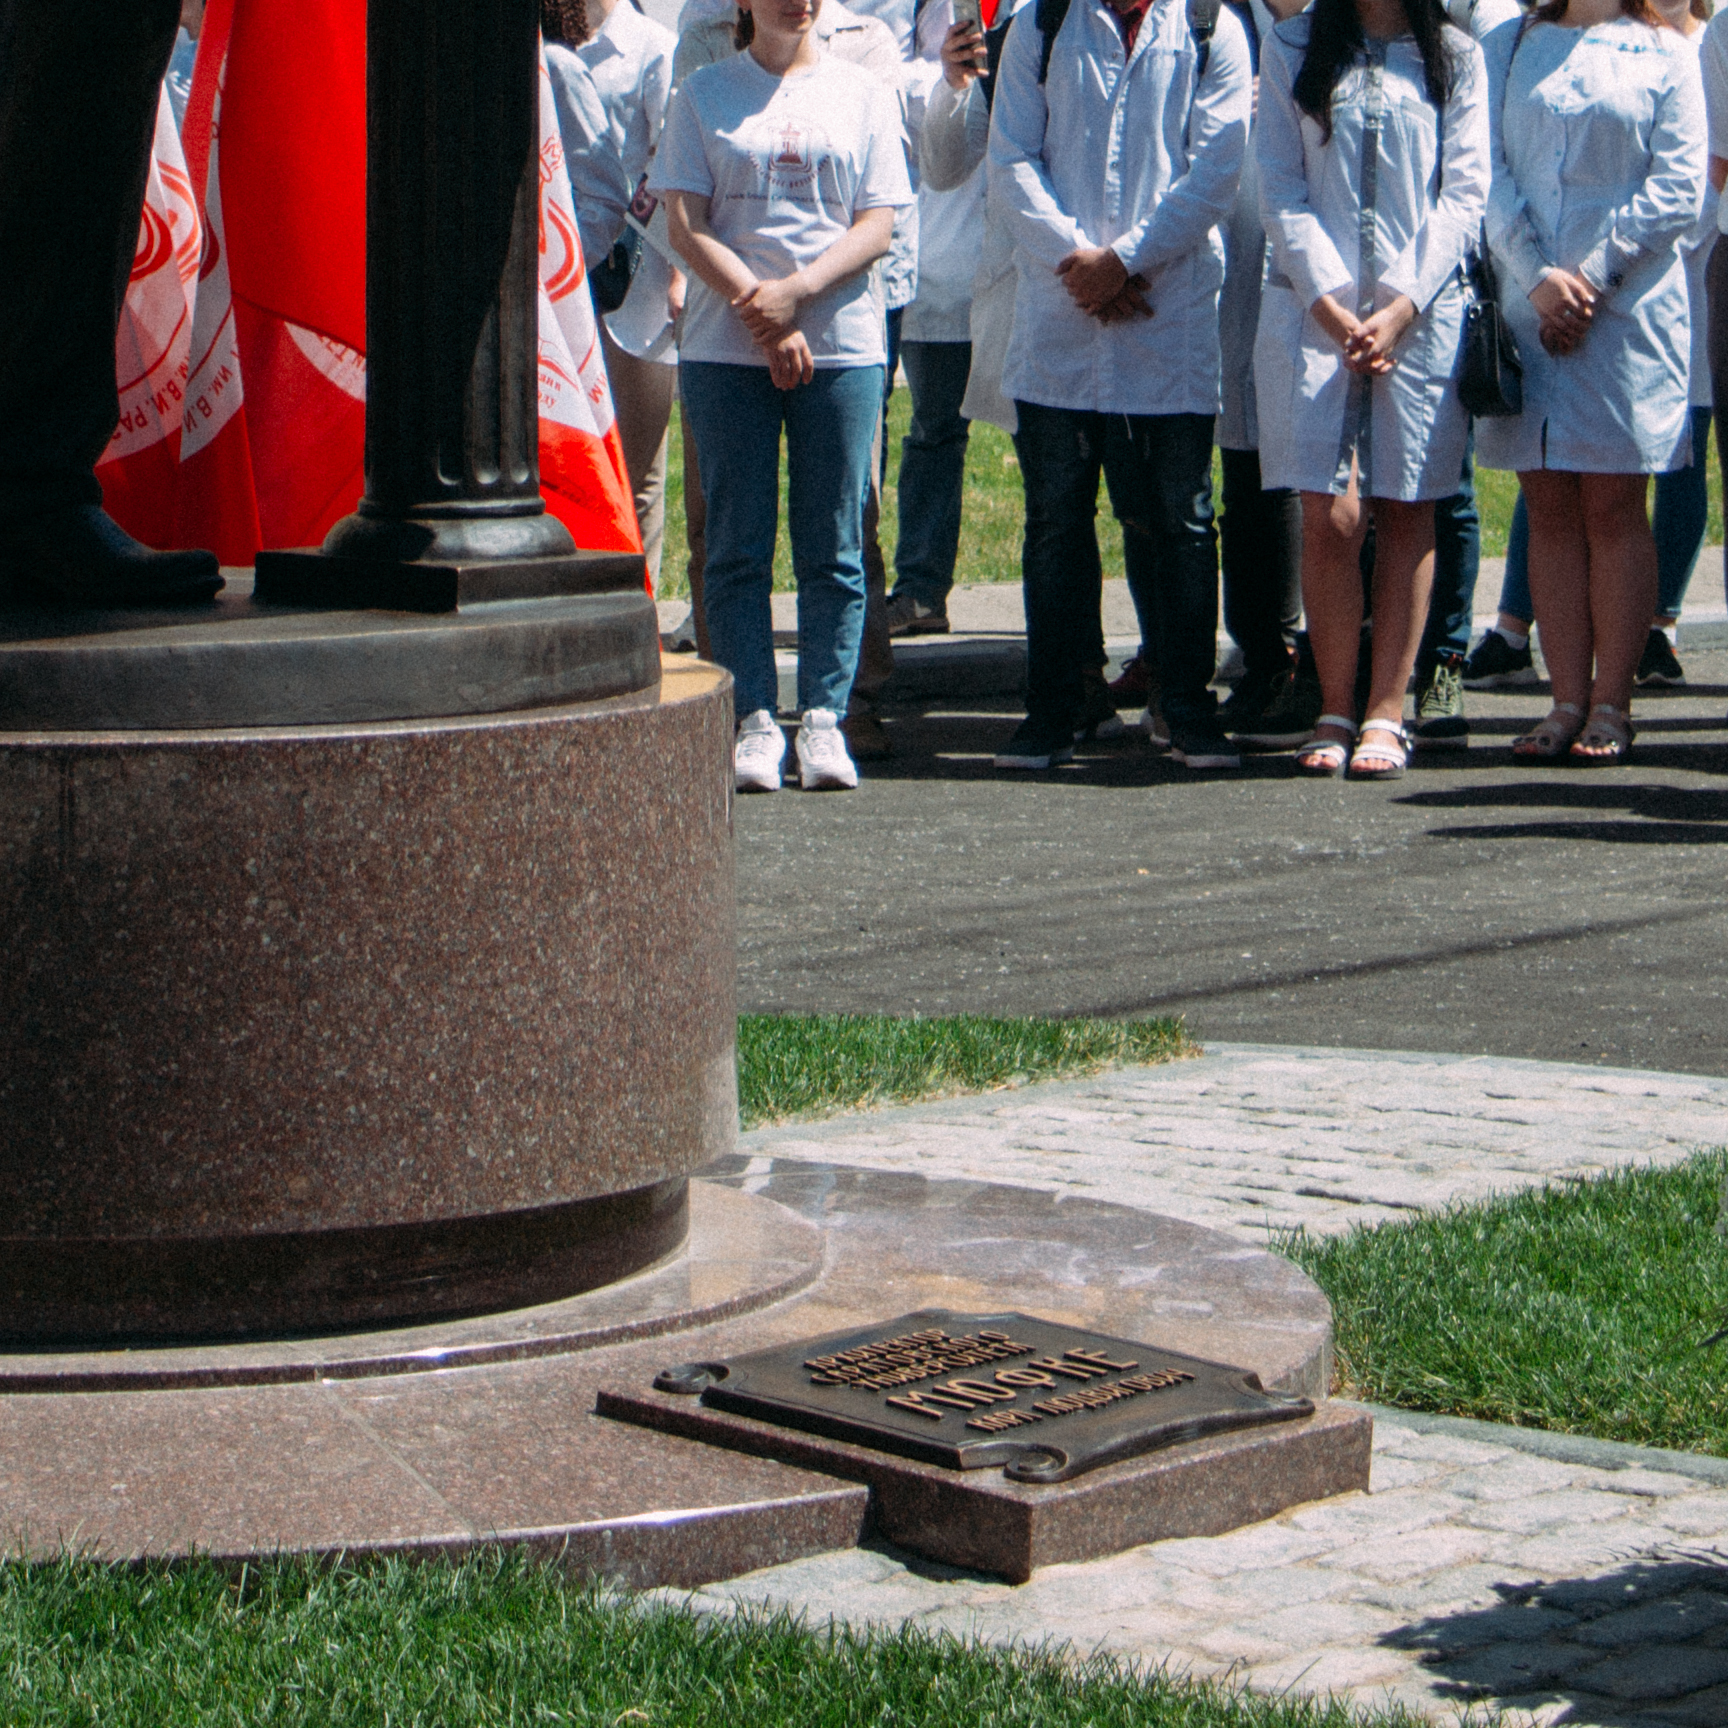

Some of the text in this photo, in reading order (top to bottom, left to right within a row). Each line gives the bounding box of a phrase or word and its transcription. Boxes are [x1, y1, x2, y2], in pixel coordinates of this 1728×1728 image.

[803, 1328, 950, 1372] АРХИТЕКТОР
[810, 1330, 1010, 1385] САРАТОВСКОГО
[850, 1340, 1036, 1391] УНИВЕРСИТЕТА
[886, 1348, 1139, 1420] МЮФКЕ
[965, 1368, 1195, 1434] КАРЛ ЛЮДВИГОВИЧ
